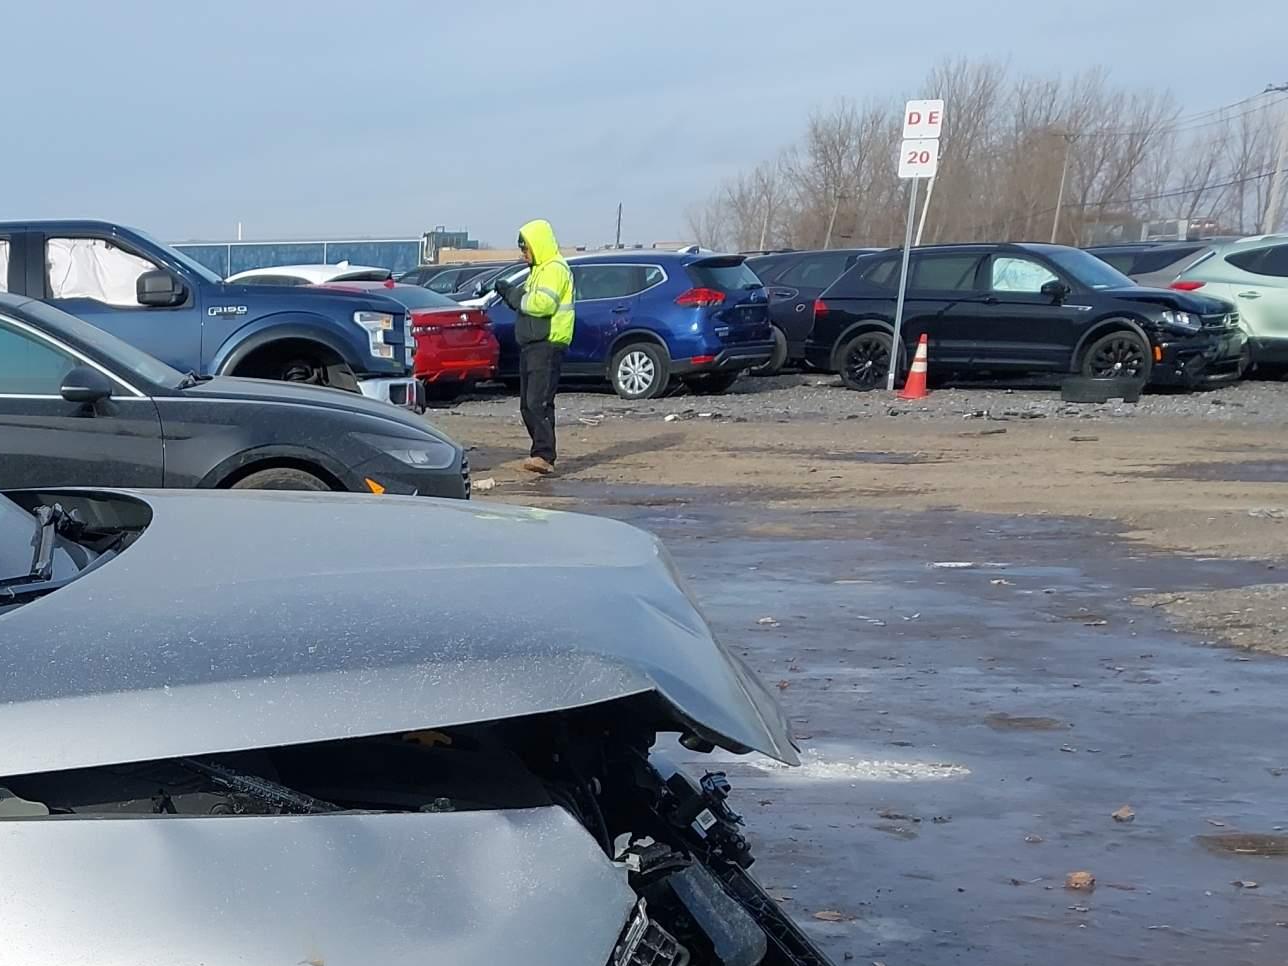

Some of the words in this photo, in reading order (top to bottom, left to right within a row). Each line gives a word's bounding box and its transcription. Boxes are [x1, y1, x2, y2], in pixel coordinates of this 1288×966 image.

[908, 112, 922, 125] D
[928, 111, 940, 125] E
[907, 151, 930, 164] 20
